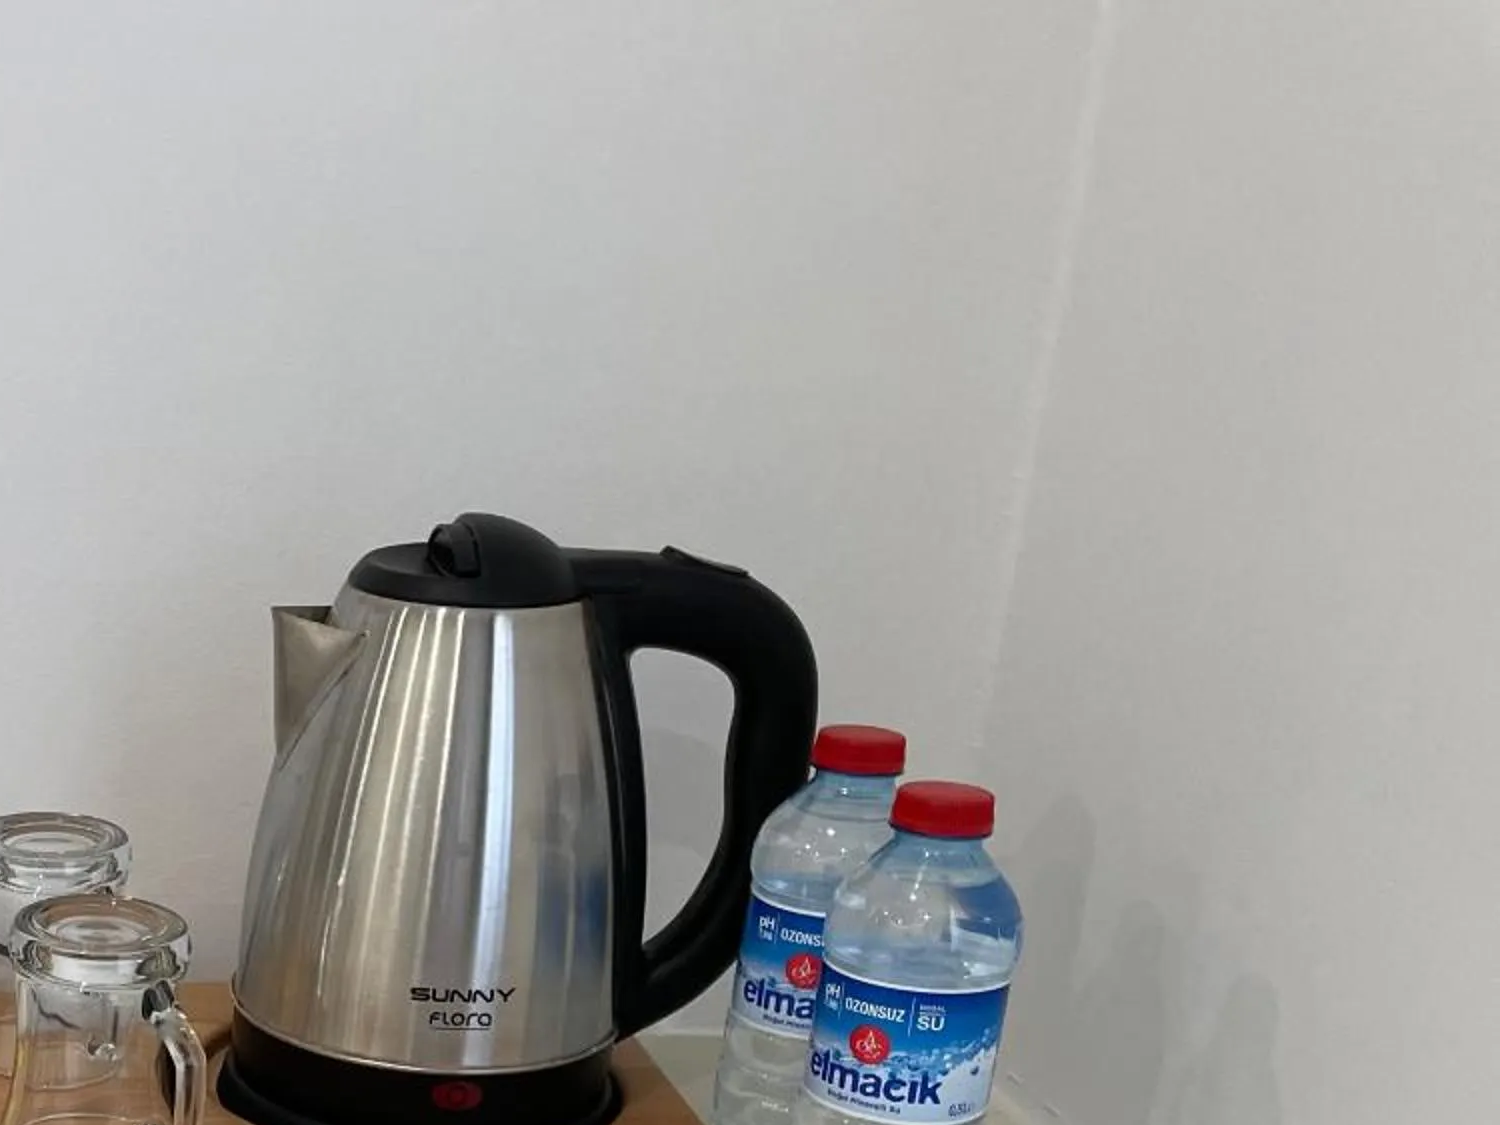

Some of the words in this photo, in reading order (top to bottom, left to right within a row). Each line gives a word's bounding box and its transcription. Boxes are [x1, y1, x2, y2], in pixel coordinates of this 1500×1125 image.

[410, 987, 516, 1002] SUNNY
[743, 979, 814, 1018] elma
[845, 997, 906, 1023] OZONSUZ
[916, 1015, 946, 1031] SU
